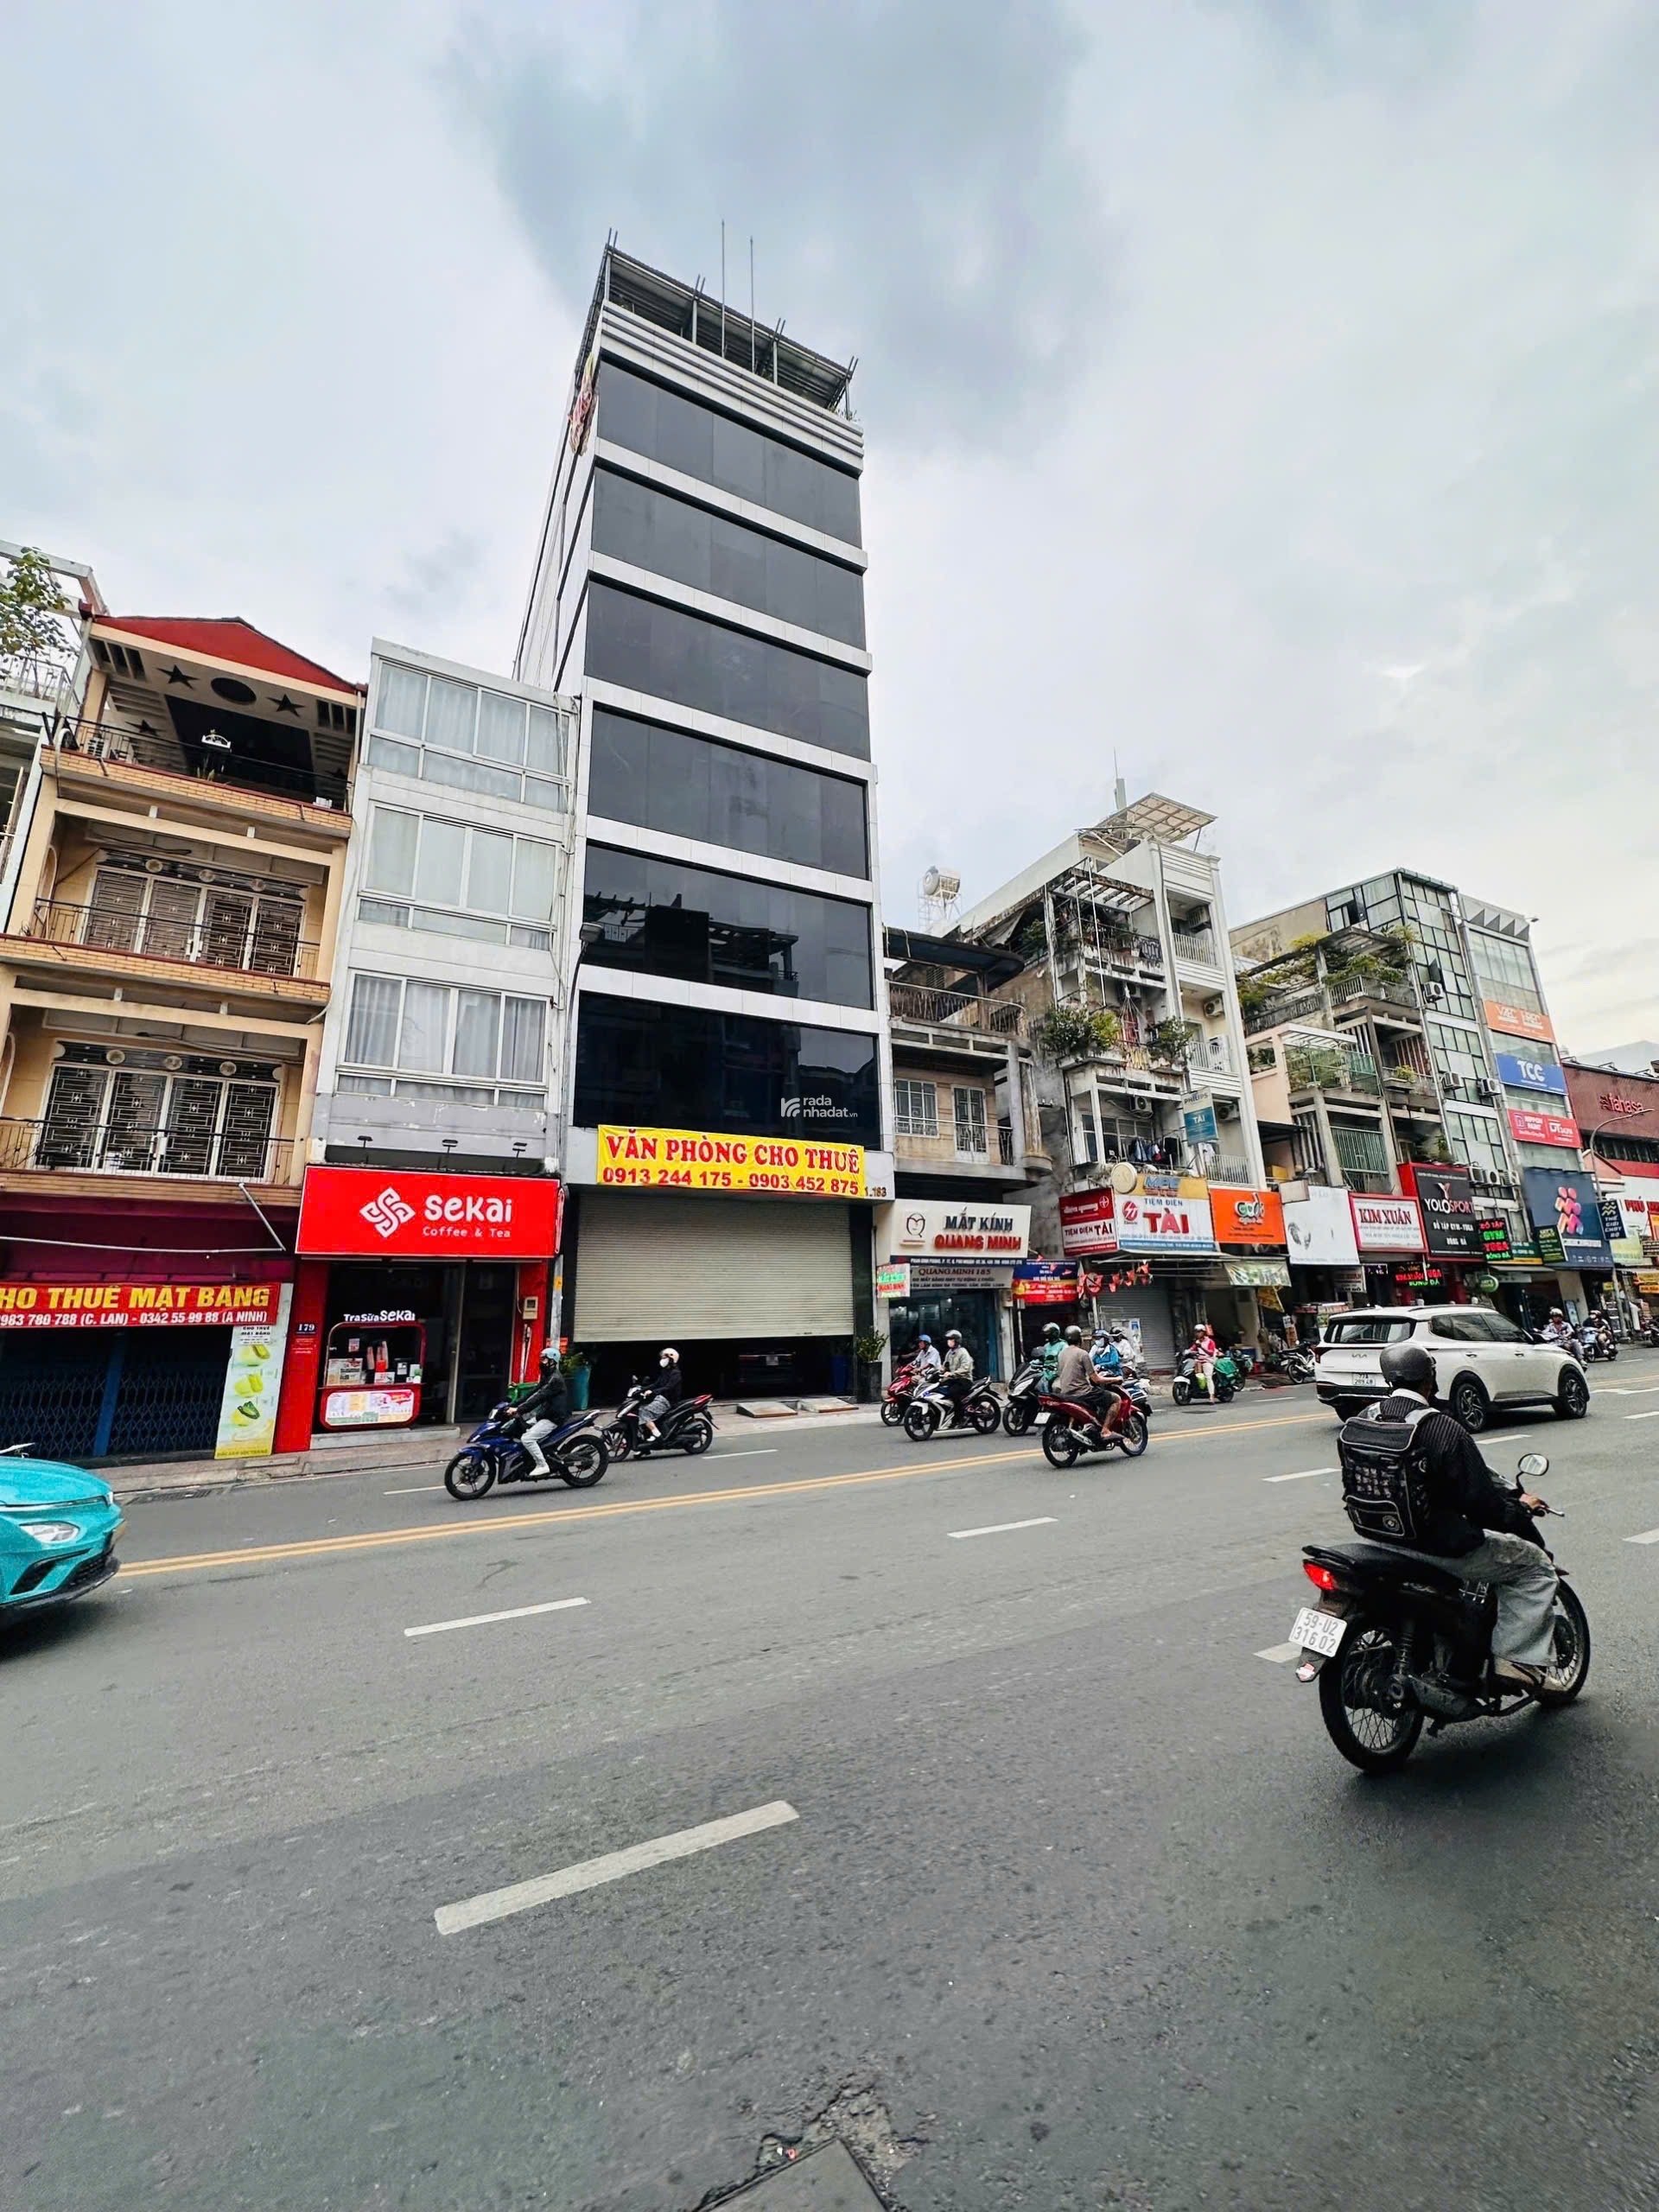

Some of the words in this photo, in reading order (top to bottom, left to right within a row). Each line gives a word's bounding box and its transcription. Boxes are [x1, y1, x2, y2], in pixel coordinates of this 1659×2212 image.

[1516, 1060, 1546, 1083] TCC
[606, 1128, 658, 1160] VĂN
[665, 1135, 747, 1165] PHÒNG
[753, 1144, 799, 1167] CHO
[804, 1147, 861, 1174] THUÊ
[602, 1166, 651, 1185] 0913
[658, 1169, 692, 1185] 244
[699, 1171, 732, 1187] 175
[748, 1173, 791, 1190] 0903
[795, 1176, 825, 1192] 452
[830, 1178, 859, 1196] 875
[944, 1206, 976, 1230] MẮT
[979, 1212, 1014, 1232] KÍNH
[1142, 1207, 1190, 1234] TÀI
[1358, 1208, 1383, 1224] KIM
[422, 1225, 467, 1237] Coffee
[474, 1228, 483, 1237] &
[489, 1228, 512, 1238] Tea
[1094, 1221, 1113, 1236] TÀI
[933, 1234, 984, 1250] QUANG
[986, 1235, 1021, 1250] MINH
[48, 1285, 121, 1309] THUÊ
[0, 1313, 24, 1326] 983
[28, 1313, 51, 1325] 780
[54, 1313, 77, 1325] 788
[80, 1313, 97, 1327] (C.
[99, 1313, 129, 1326] LAN)
[140, 1313, 168, 1324] 0342
[170, 1313, 186, 1324] 55
[188, 1312, 203, 1324] 99
[204, 1312, 219, 1323] 88
[236, 1311, 267, 1323] NINH)
[298, 1323, 316, 1332] 179
[1303, 1612, 1338, 1637] 59-U2
[1294, 1626, 1337, 1654] 316.02
